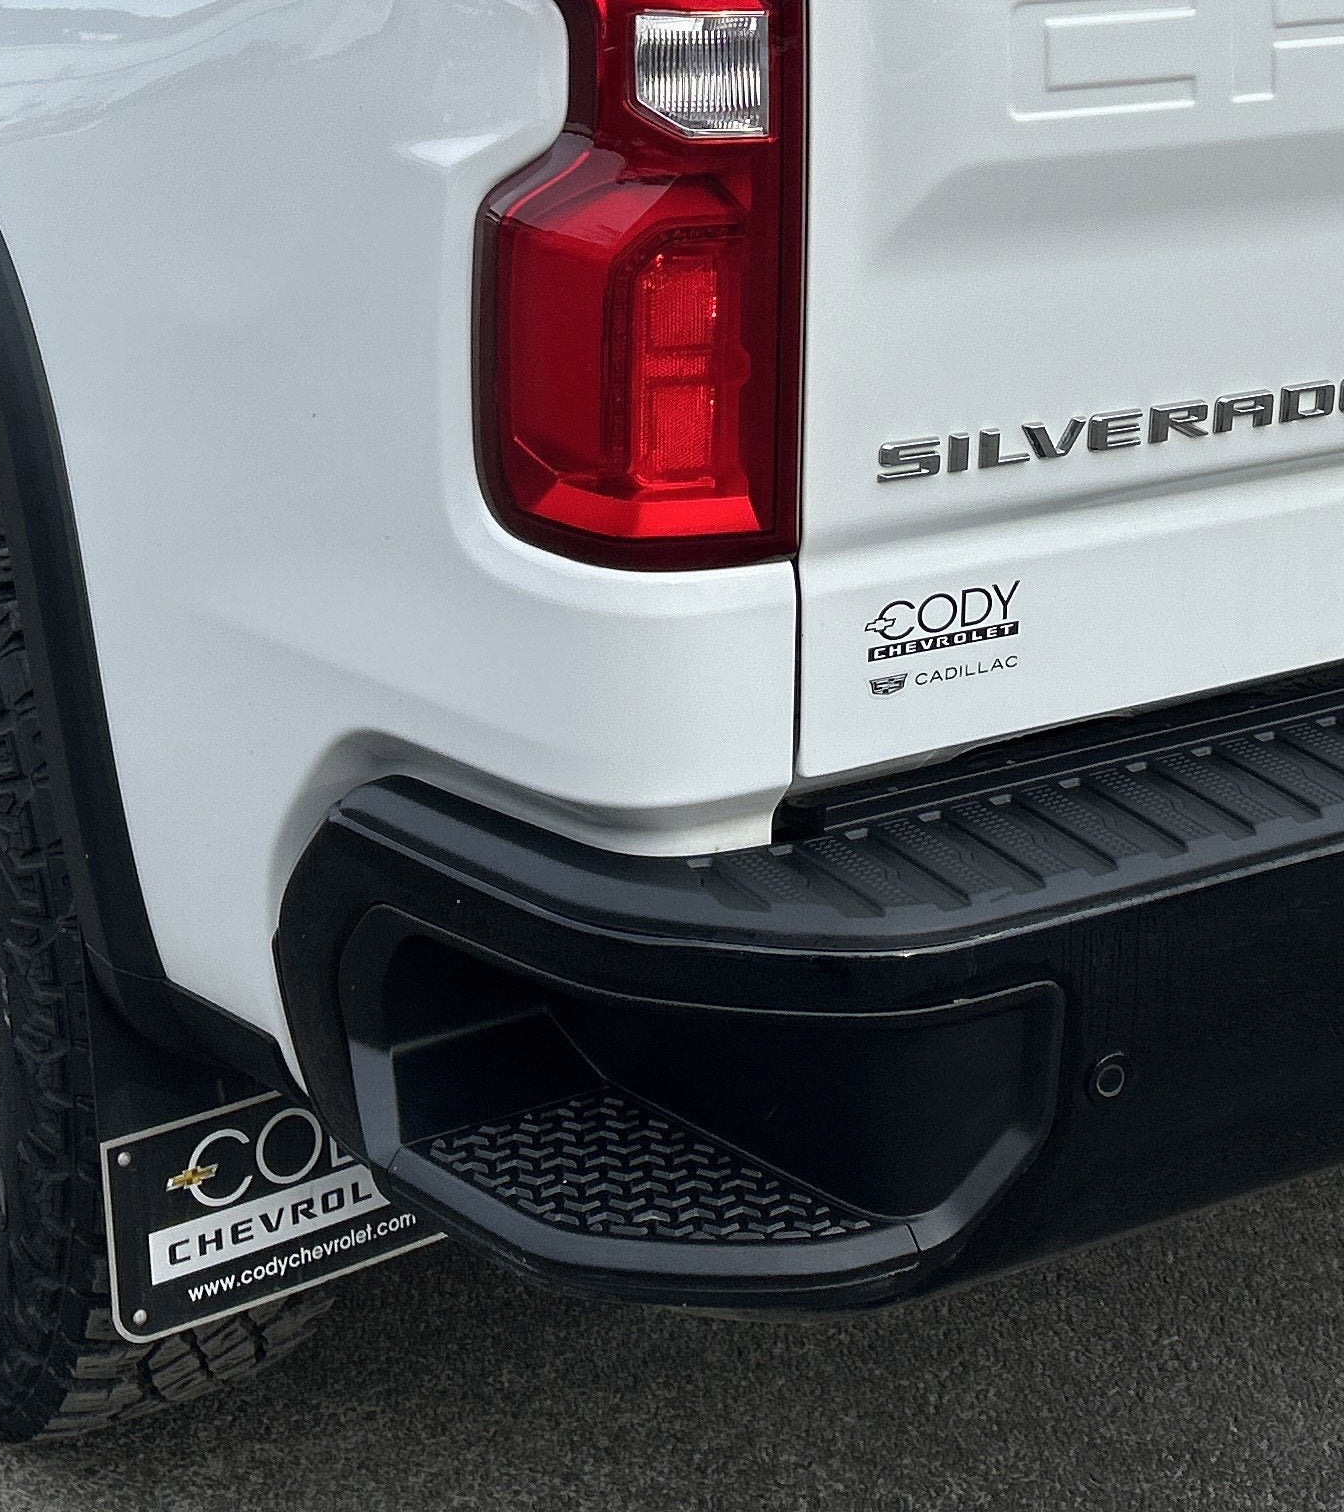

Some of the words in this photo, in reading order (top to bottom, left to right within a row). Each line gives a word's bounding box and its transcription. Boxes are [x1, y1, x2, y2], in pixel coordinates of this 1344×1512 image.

[872, 622, 1015, 661] CHEVROLET
[874, 579, 1021, 641] CODY
[914, 655, 1019, 686] CADILLAC
[186, 1106, 354, 1208] CO
[167, 1181, 374, 1267] CHEVROL
[187, 1212, 417, 1303] www.codychevrolet.com
